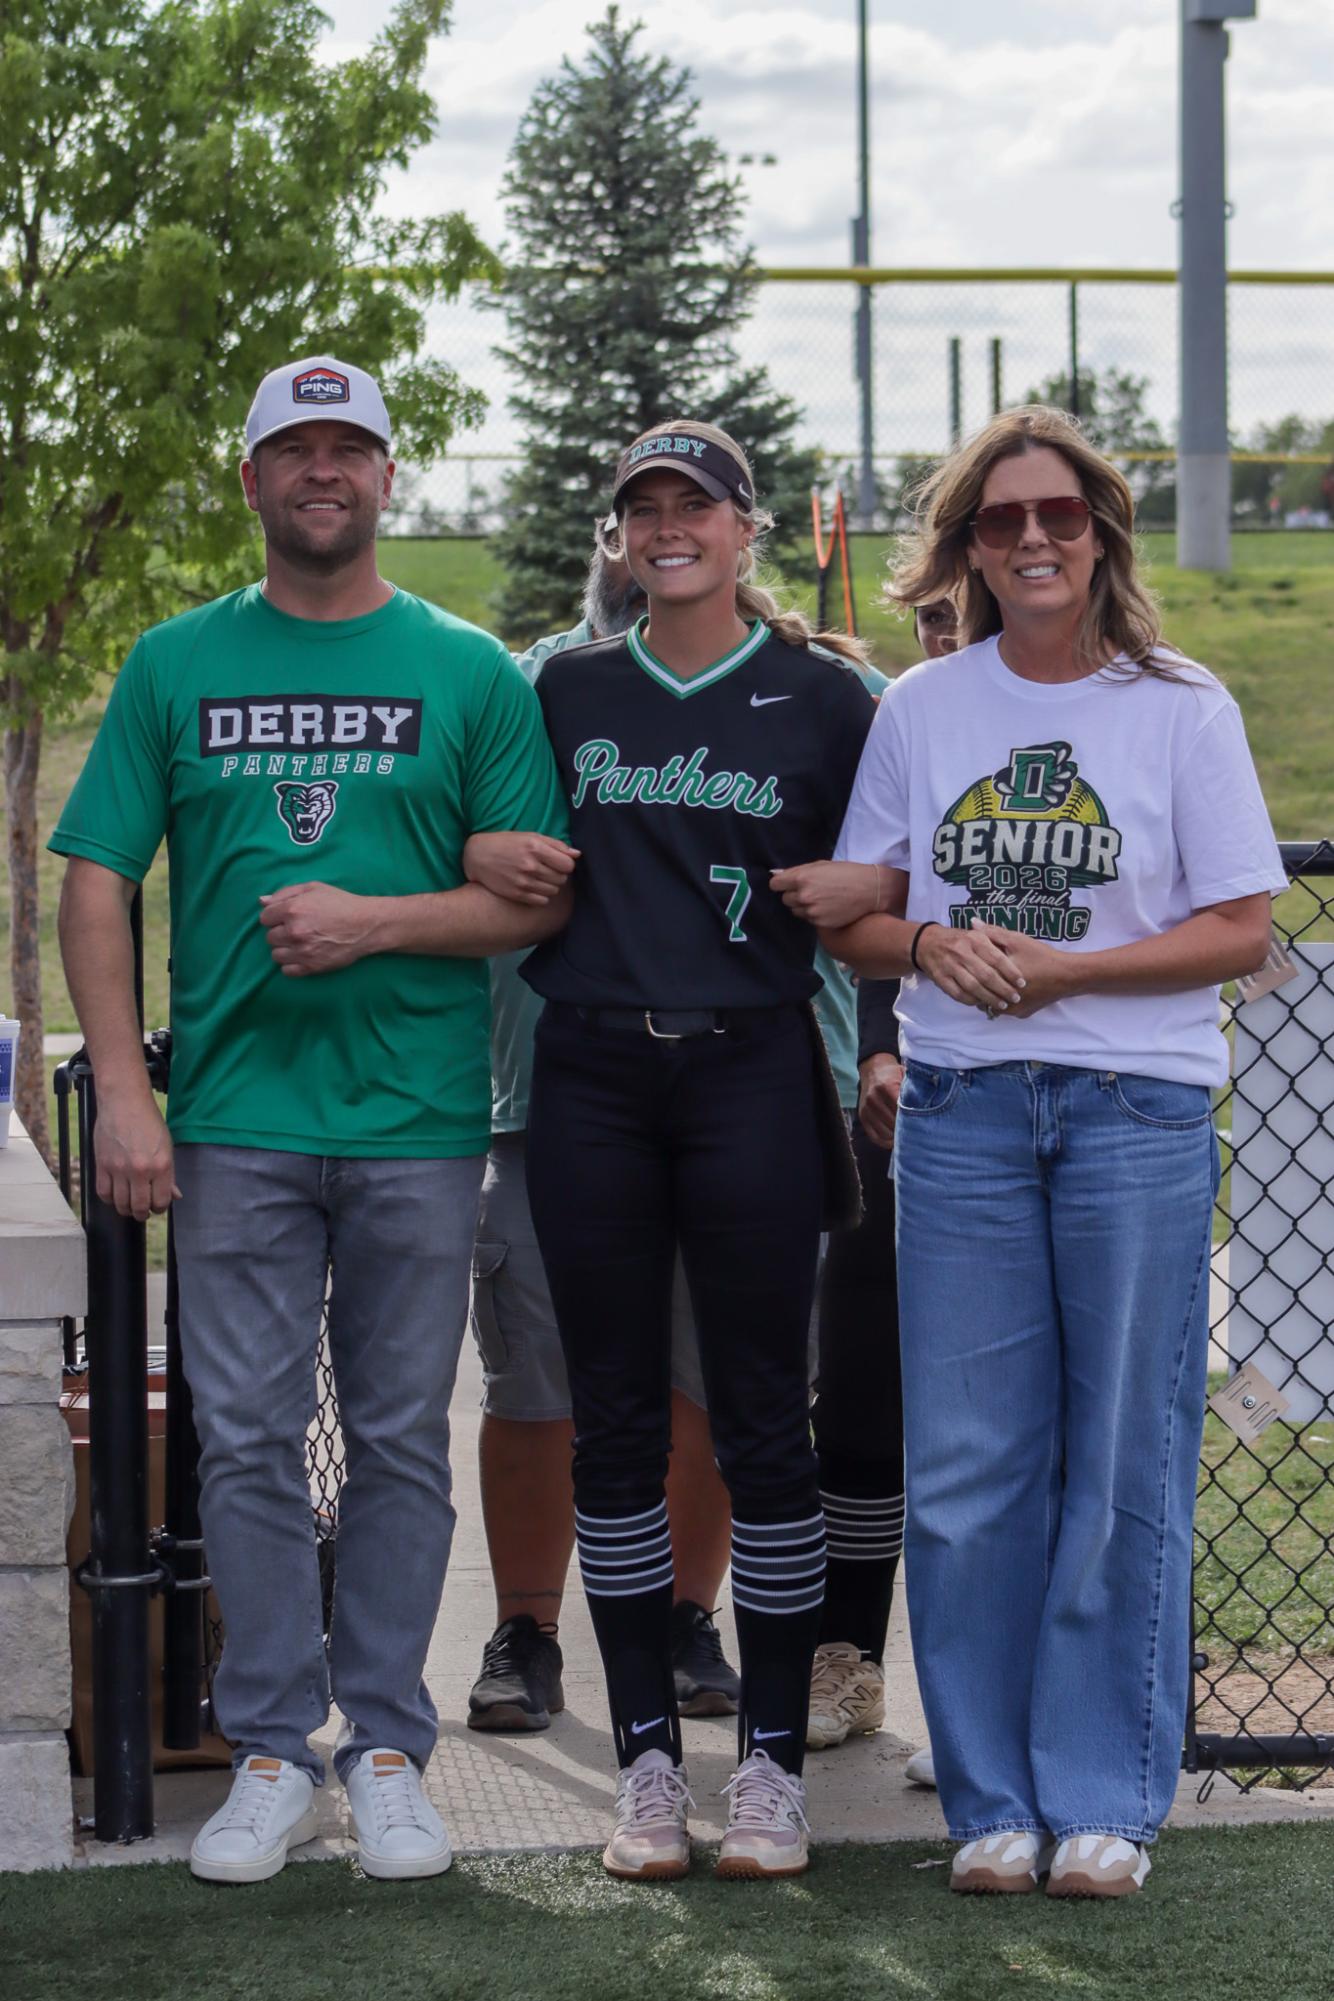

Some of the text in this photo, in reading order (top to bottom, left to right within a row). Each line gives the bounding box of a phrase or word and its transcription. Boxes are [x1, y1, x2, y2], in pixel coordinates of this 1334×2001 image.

[300, 382, 343, 394] PING
[628, 437, 707, 465] DERBY
[208, 704, 413, 748] DERBY
[221, 753, 395, 778] PANTHERS
[572, 738, 783, 818] Panthers
[933, 819, 1121, 879] SENIOR
[969, 864, 1068, 892] 2026
[710, 864, 752, 942] 7
[1016, 889, 1066, 911] final
